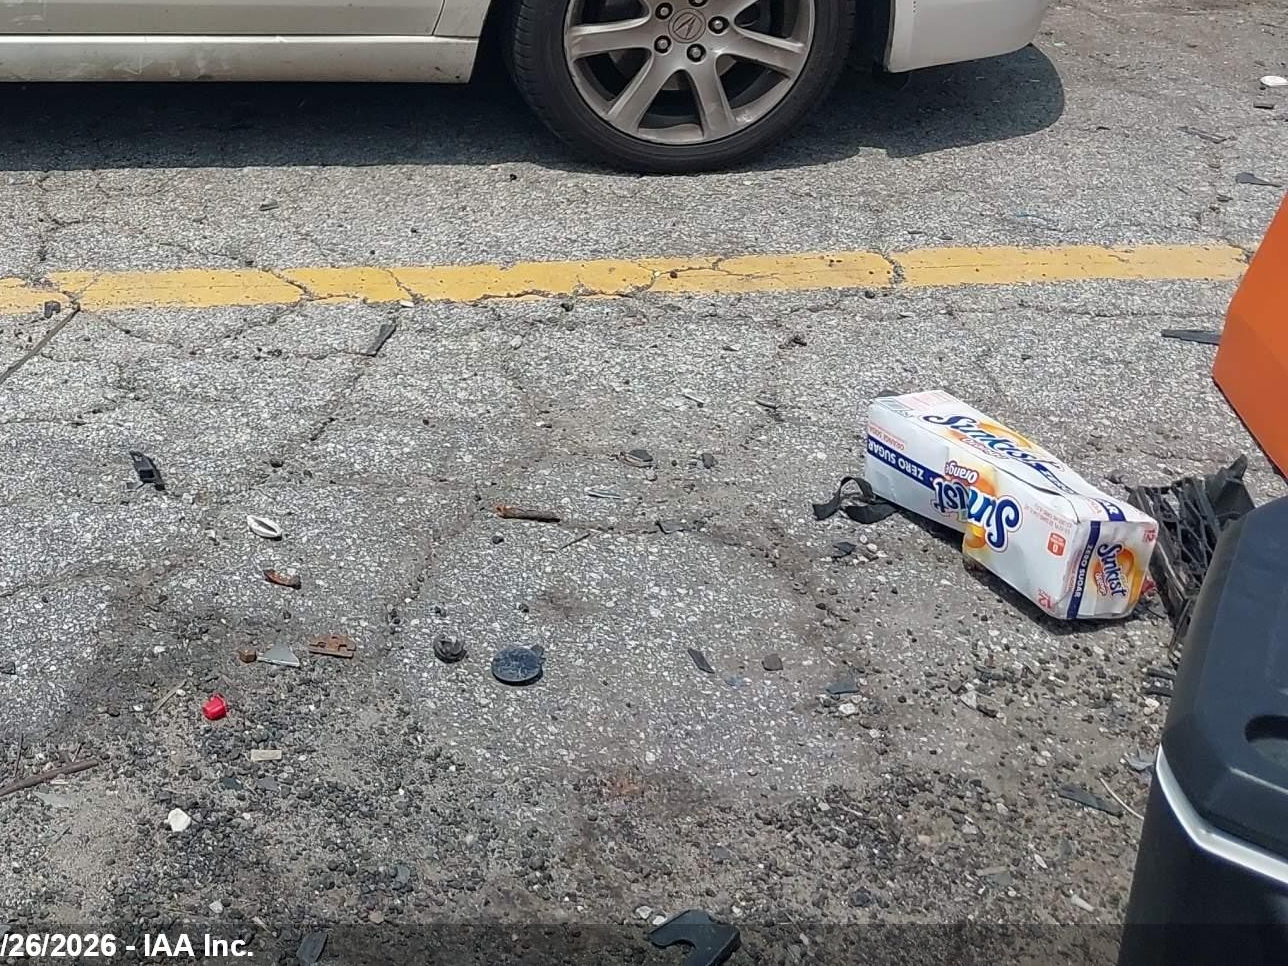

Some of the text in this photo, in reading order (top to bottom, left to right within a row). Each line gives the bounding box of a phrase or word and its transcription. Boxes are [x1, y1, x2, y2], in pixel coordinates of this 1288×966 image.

[868, 438, 925, 481] ZERO SUGAR
[921, 414, 1062, 470] Sunkist
[944, 460, 979, 484] Orange
[1081, 544, 1093, 568] ZERO
[1097, 543, 1128, 596] Sunkist
